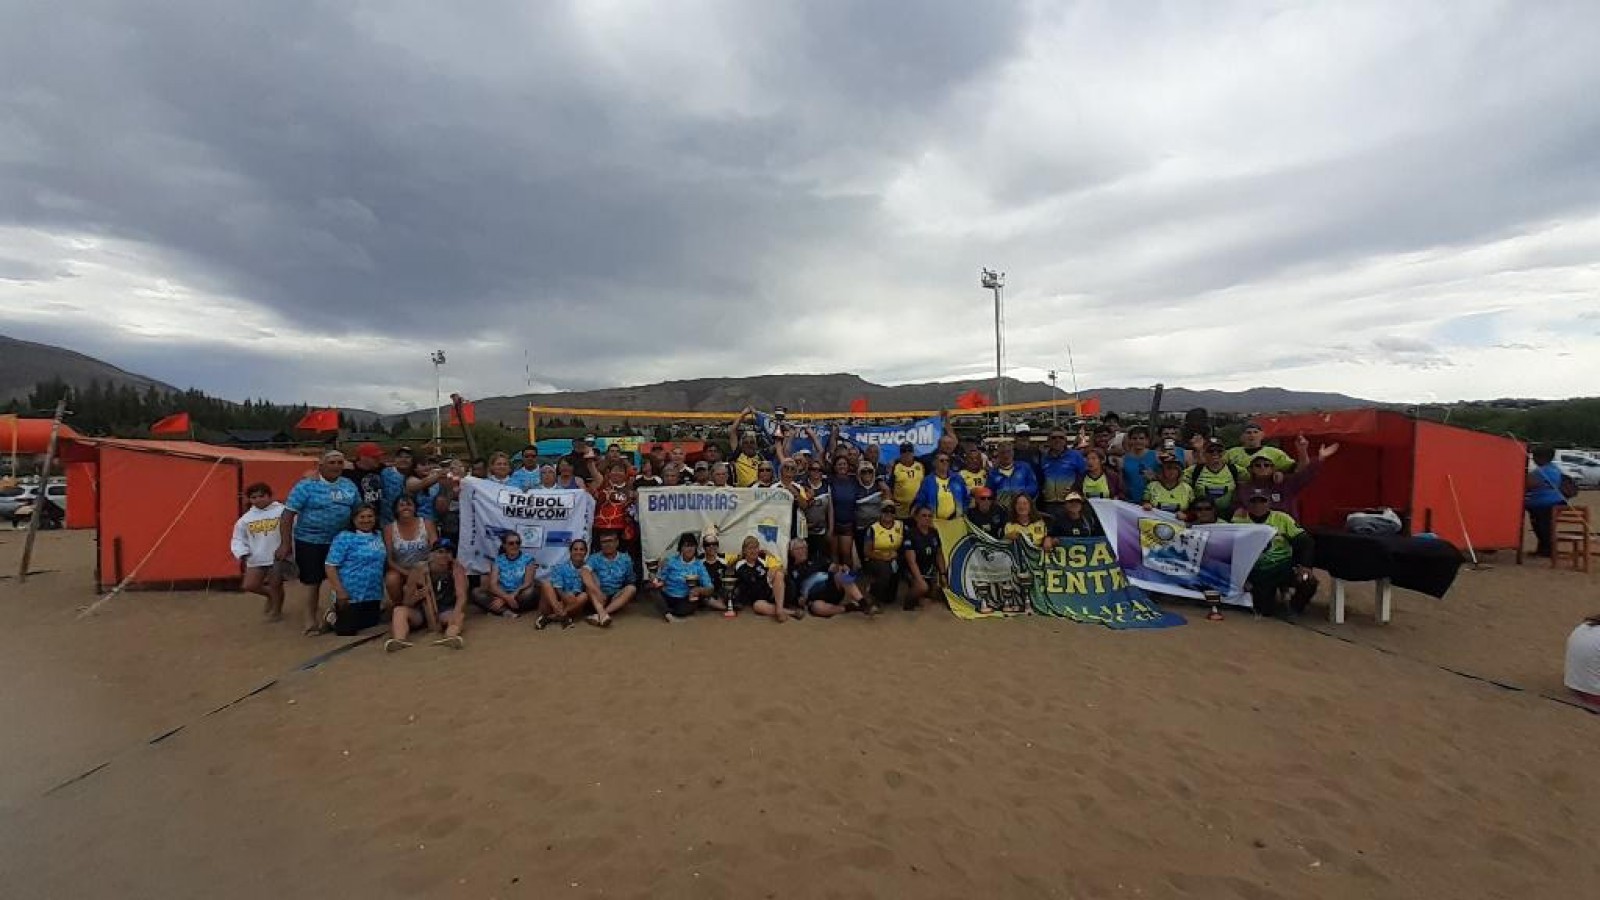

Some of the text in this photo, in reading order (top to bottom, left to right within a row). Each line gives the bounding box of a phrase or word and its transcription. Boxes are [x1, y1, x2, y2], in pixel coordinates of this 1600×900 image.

[856, 424, 934, 445] NEWCOM
[648, 493, 738, 511] BANDURRIAS
[505, 506, 566, 519] NEWCOM
